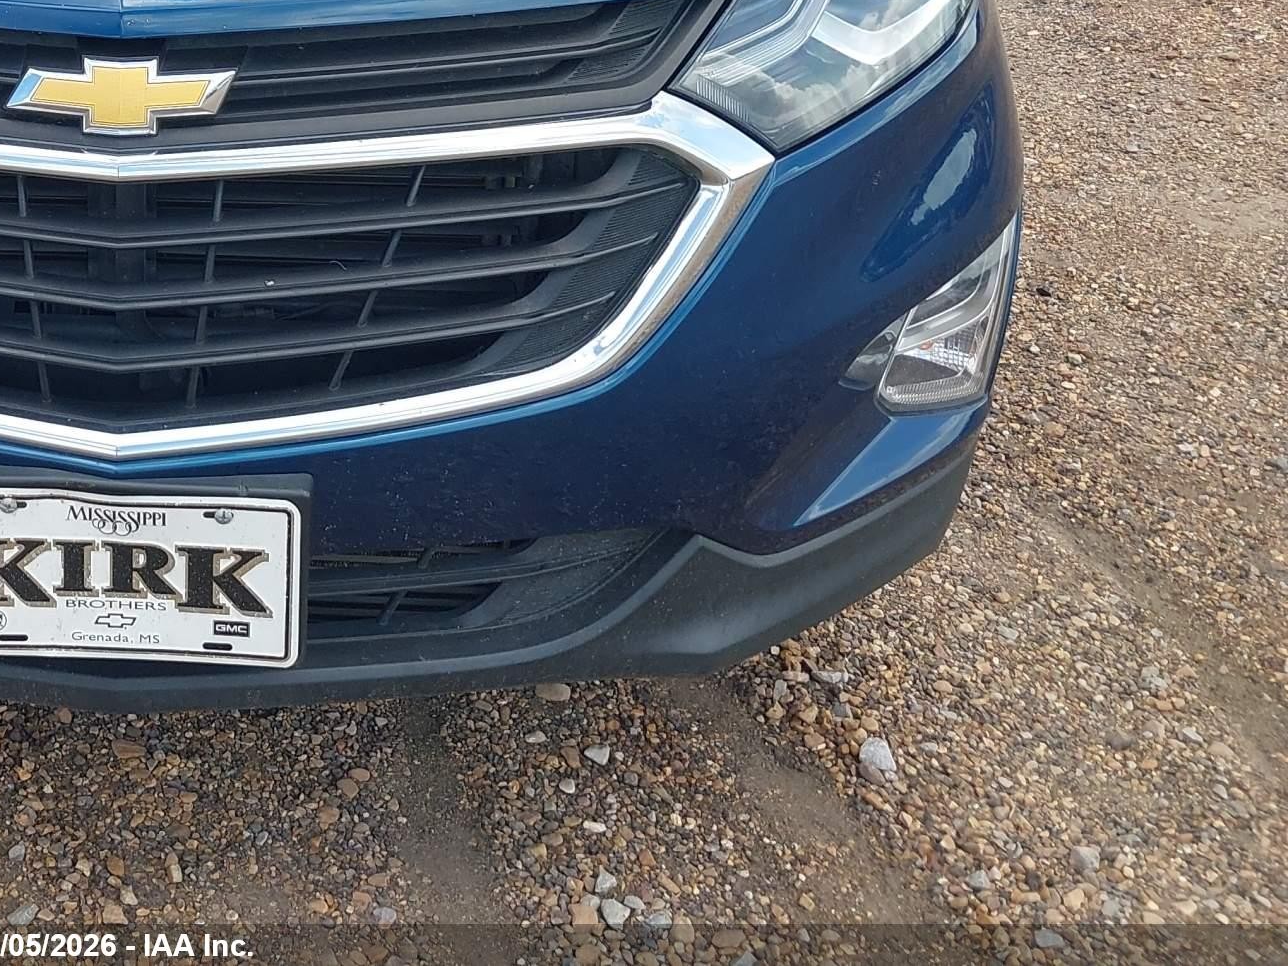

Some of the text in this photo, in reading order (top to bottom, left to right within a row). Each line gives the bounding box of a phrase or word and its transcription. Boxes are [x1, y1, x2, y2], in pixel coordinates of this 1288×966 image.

[65, 599, 168, 612] BROTHERS
[215, 623, 248, 634] GMC
[71, 631, 161, 645] Grenada, MS
